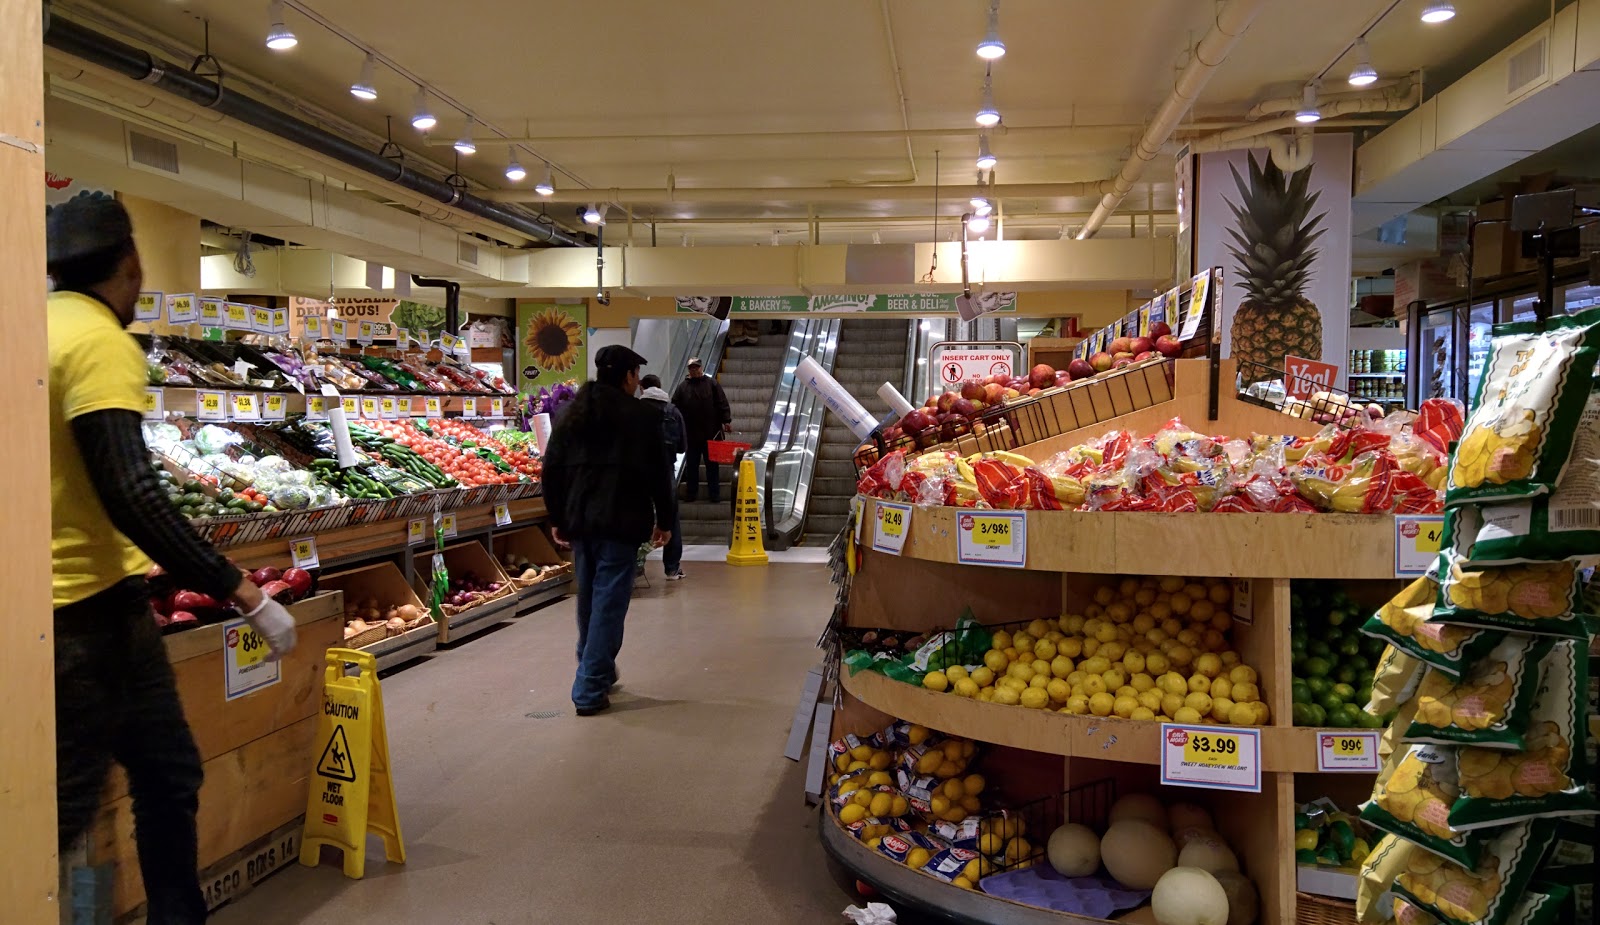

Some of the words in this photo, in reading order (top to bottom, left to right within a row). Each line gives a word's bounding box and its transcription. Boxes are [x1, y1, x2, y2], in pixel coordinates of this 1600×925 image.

[740, 300, 747, 310] &
[749, 299, 781, 310] BAKERY
[887, 299, 909, 310] BEER
[911, 299, 918, 310] &
[920, 298, 939, 310] DELI
[296, 305, 379, 318] DELIIOUS!
[1290, 364, 1331, 396] Yes!
[884, 510, 902, 526] $2.49
[981, 522, 1009, 535] 3/98¢
[1427, 529, 1442, 542] 4/
[324, 701, 359, 720] CAUTION
[1192, 736, 1236, 754] $3.99
[1341, 739, 1362, 751] 99¢
[327, 781, 342, 794] WET
[322, 792, 344, 806] FLOOR
[200, 869, 240, 905] ASCO
[281, 836, 293, 861] 14
